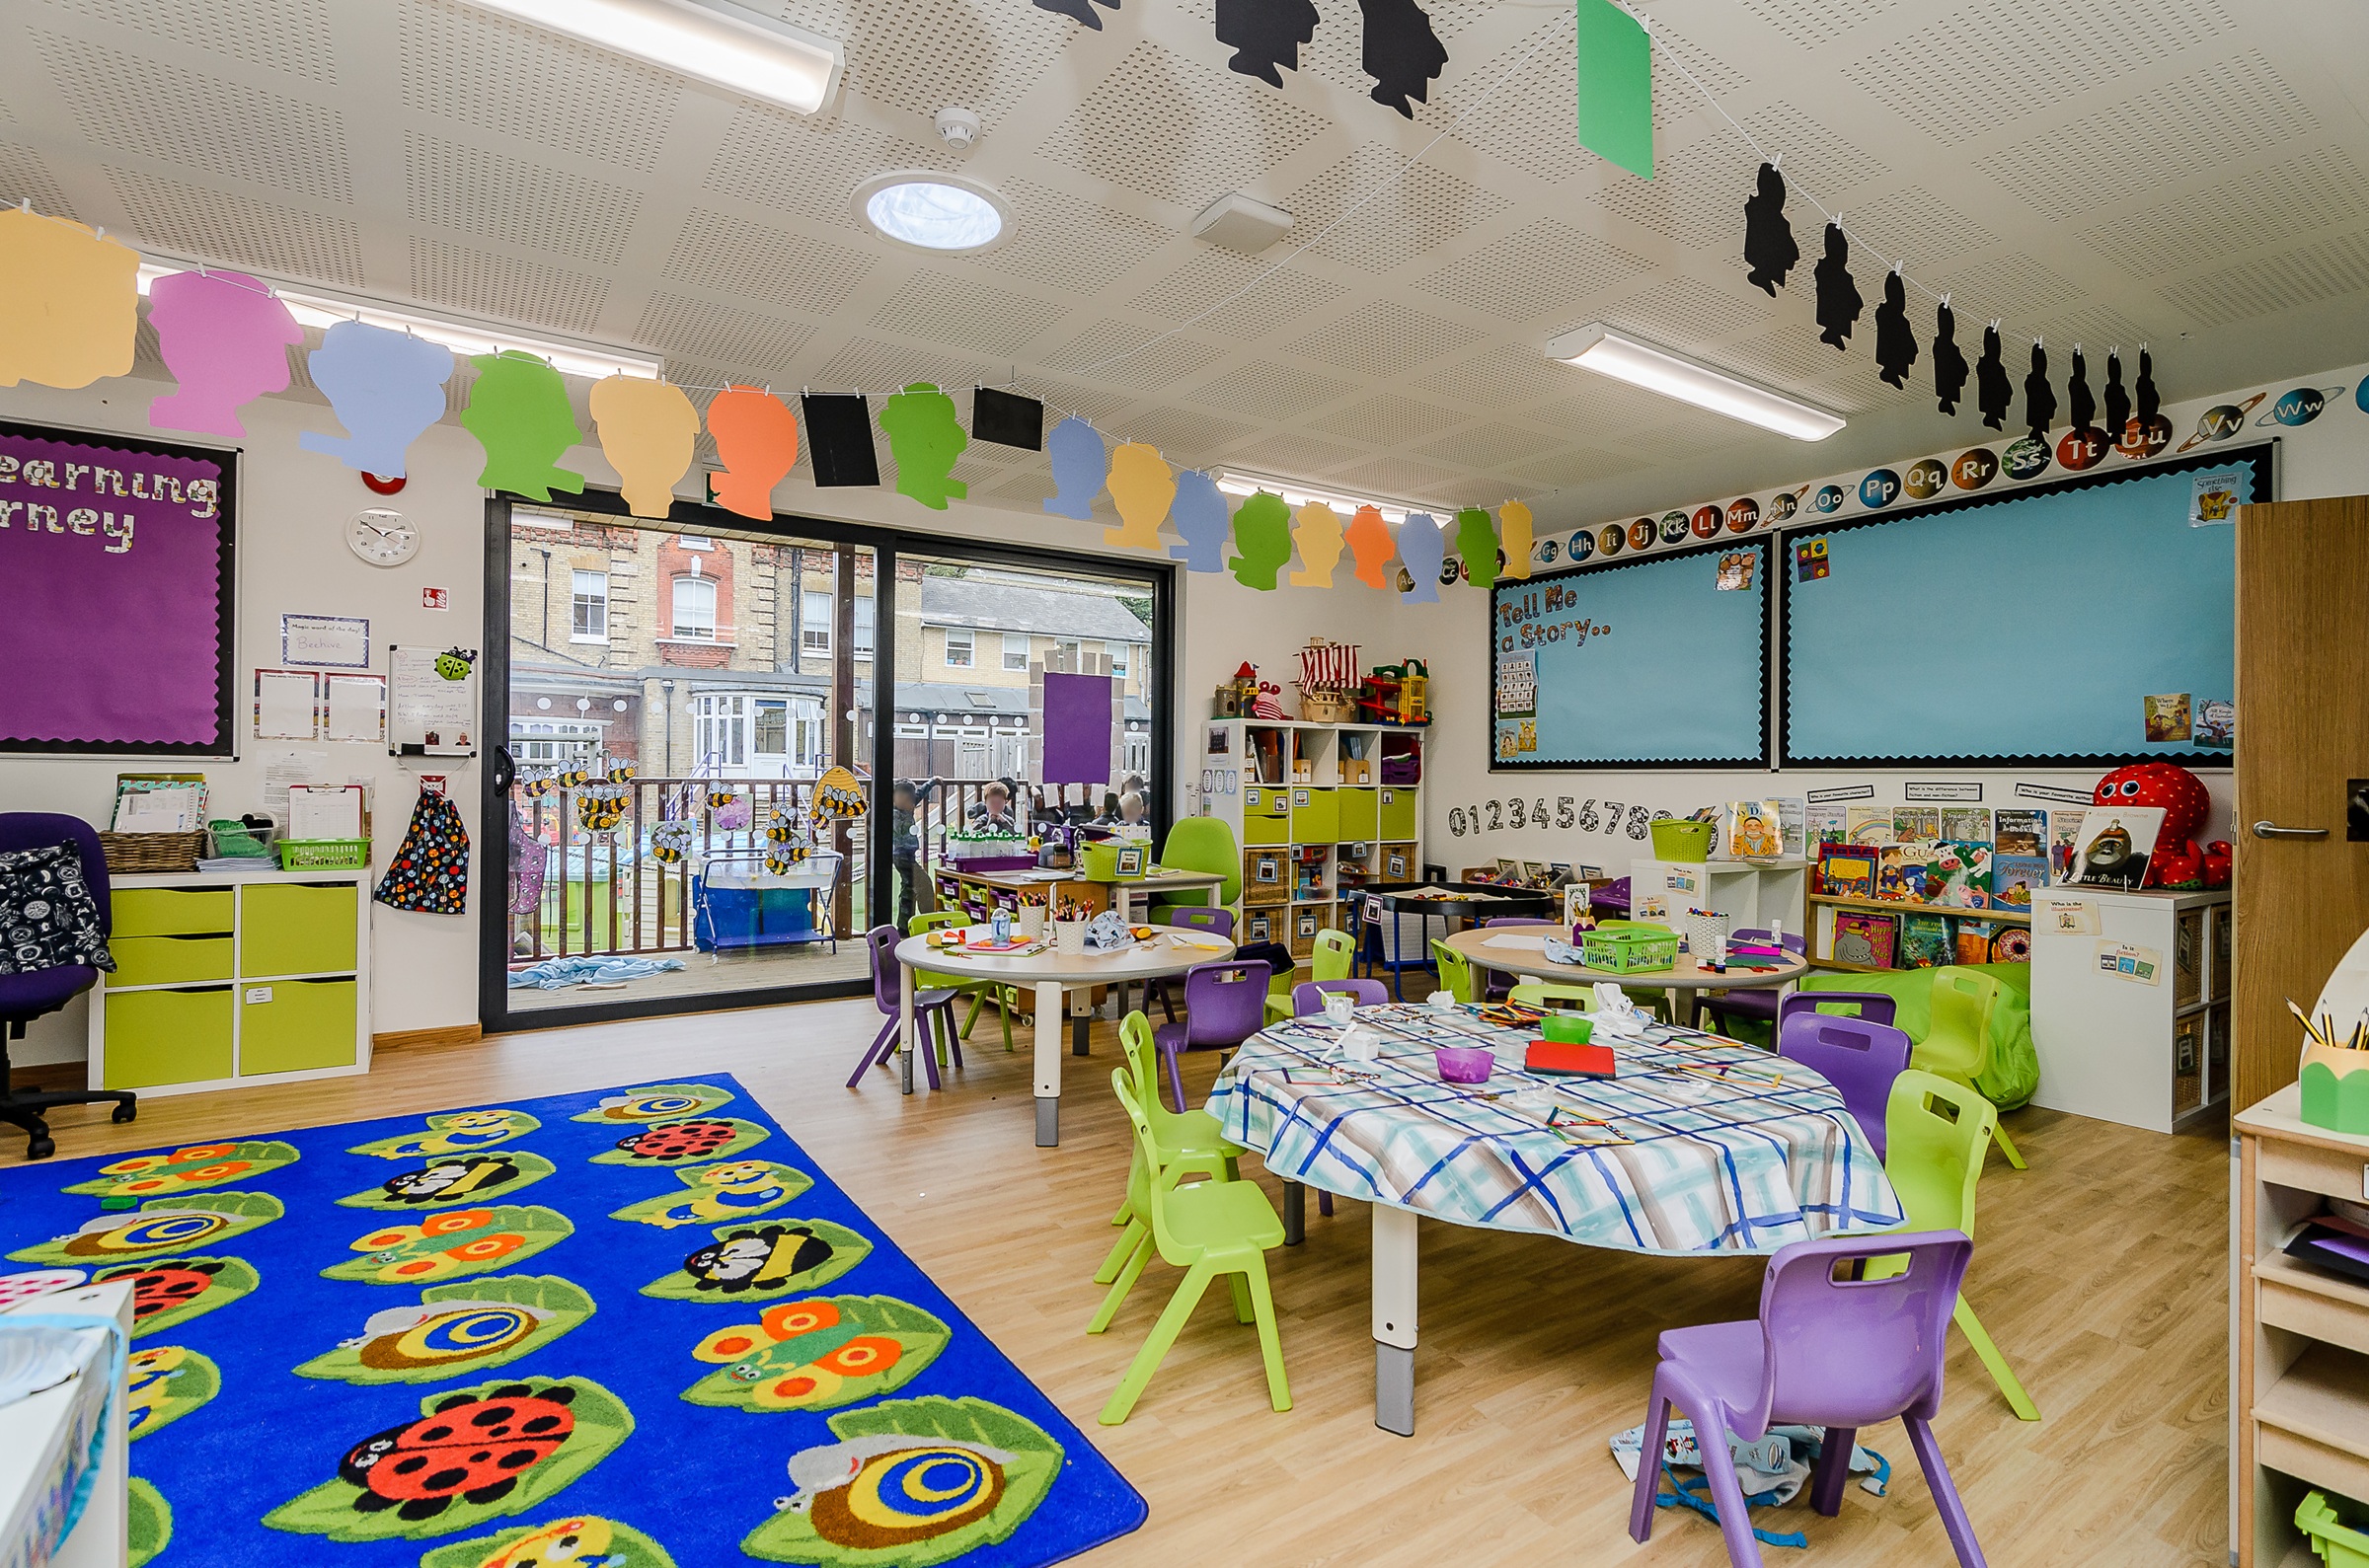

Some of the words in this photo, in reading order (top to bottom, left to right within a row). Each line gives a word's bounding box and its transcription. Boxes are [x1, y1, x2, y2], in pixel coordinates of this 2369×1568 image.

[1543, 544, 1558, 560] Gg
[1571, 538, 1592, 554] Hh
[1605, 532, 1618, 548] Ii
[1634, 525, 1649, 544] Jj
[1662, 520, 1688, 537] Kk
[1698, 513, 1717, 531] Ll
[1726, 508, 1758, 525] Mm
[1773, 499, 1796, 513] Nn
[1817, 493, 1842, 507] Oo
[1866, 480, 1894, 500] Pp
[1907, 468, 1944, 489] Qq
[1961, 460, 1991, 481] Rr
[2012, 447, 2041, 472] Ss
[2067, 439, 2098, 461] Tt
[2121, 426, 2167, 449] Uu
[2200, 414, 2244, 436] Vv
[2276, 399, 2325, 419] Ww
[2196, 476, 2237, 489] Something
[1498, 593, 1541, 628] Tell
[1545, 583, 1578, 614] Me
[296, 635, 343, 649] Beehive
[1501, 635, 1514, 652] a
[1997, 860, 2046, 878] Forever
[2069, 871, 2097, 883] LTTLE
[2098, 873, 2134, 885] BEAUY
[1871, 925, 1891, 934] Hippo
[1872, 935, 1886, 944] Has
[1873, 947, 1888, 960] Hat
[2115, 949, 2140, 958] fiction?
